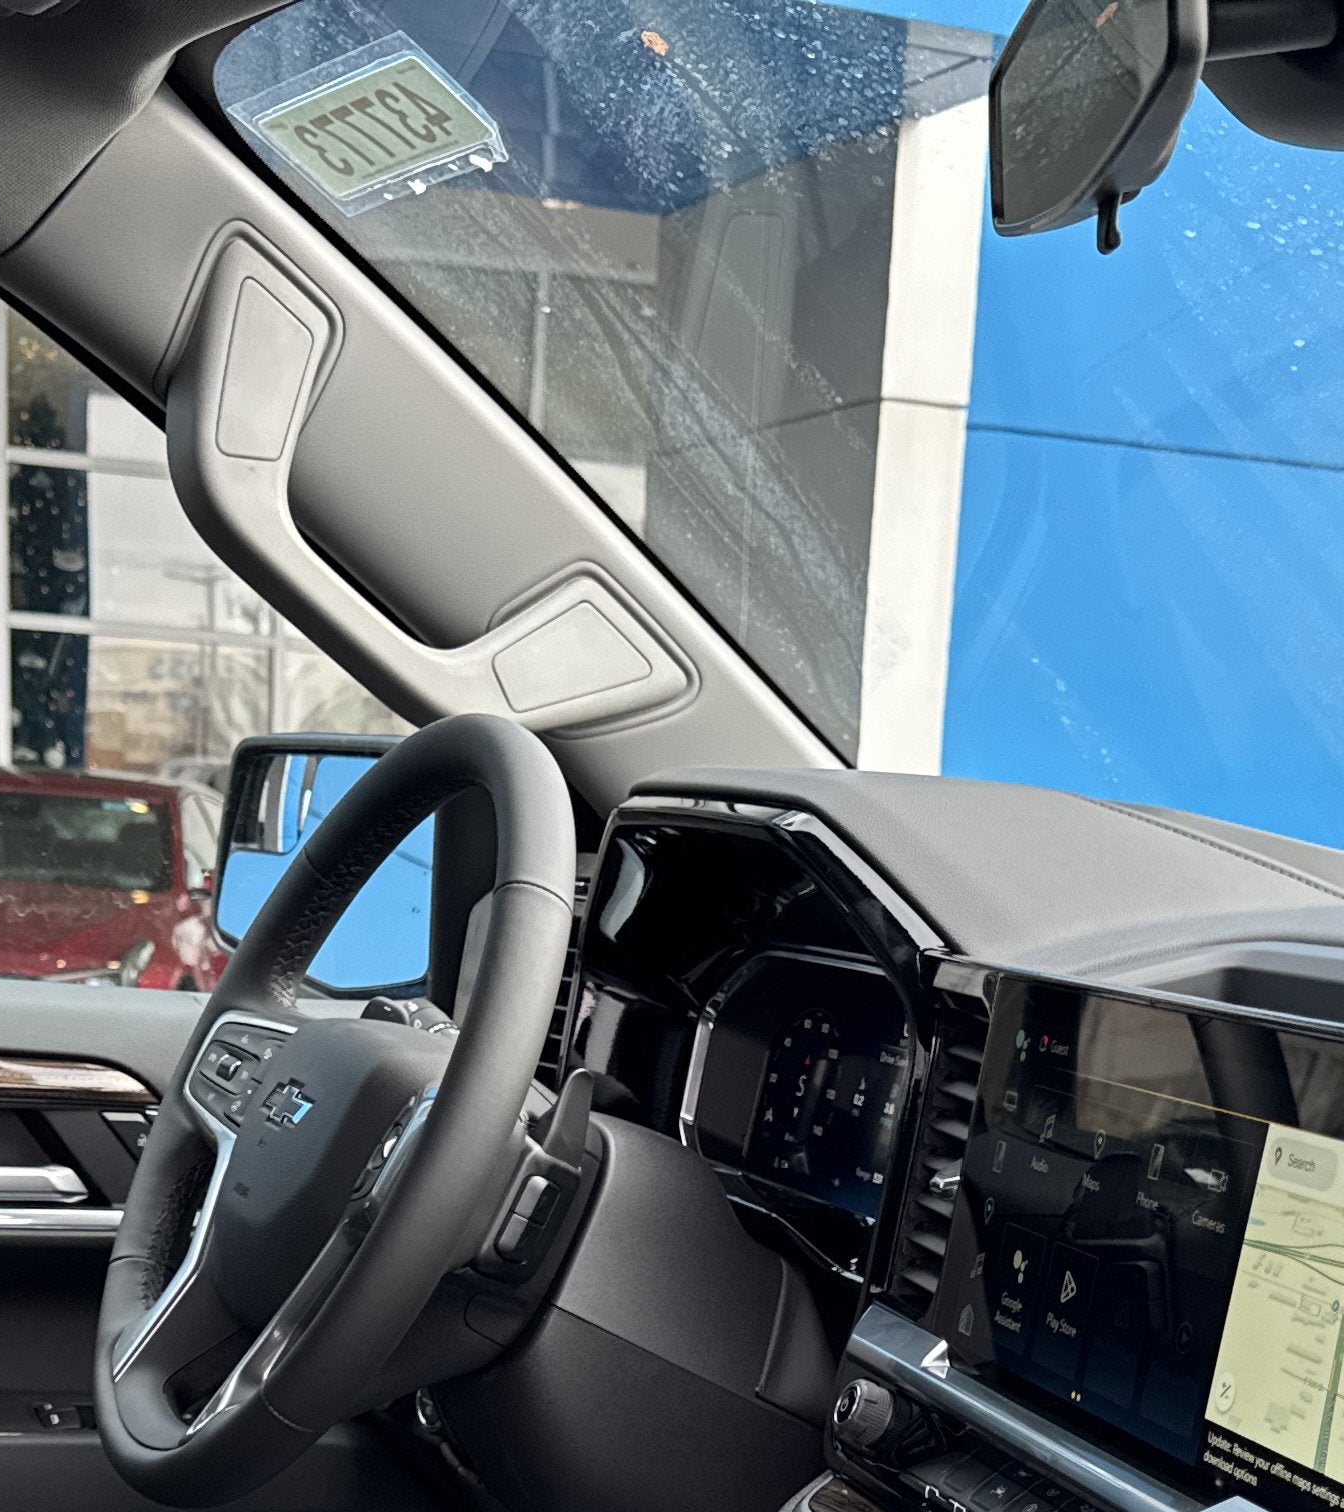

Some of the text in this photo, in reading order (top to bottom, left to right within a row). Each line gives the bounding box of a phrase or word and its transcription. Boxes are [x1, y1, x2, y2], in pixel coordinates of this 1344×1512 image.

[1030, 1155, 1049, 1174] Audio
[1287, 1152, 1316, 1173] Search
[1081, 1173, 1100, 1192] Maps
[1135, 1191, 1159, 1211] Phone
[1191, 1209, 1227, 1235] Cameras
[1203, 1450, 1258, 1487] download options
[1232, 1443, 1255, 1464] Review
[1254, 1457, 1271, 1472] your
[1269, 1462, 1292, 1483] offline
[1291, 1474, 1312, 1493] maps
[1311, 1484, 1340, 1508] settings
